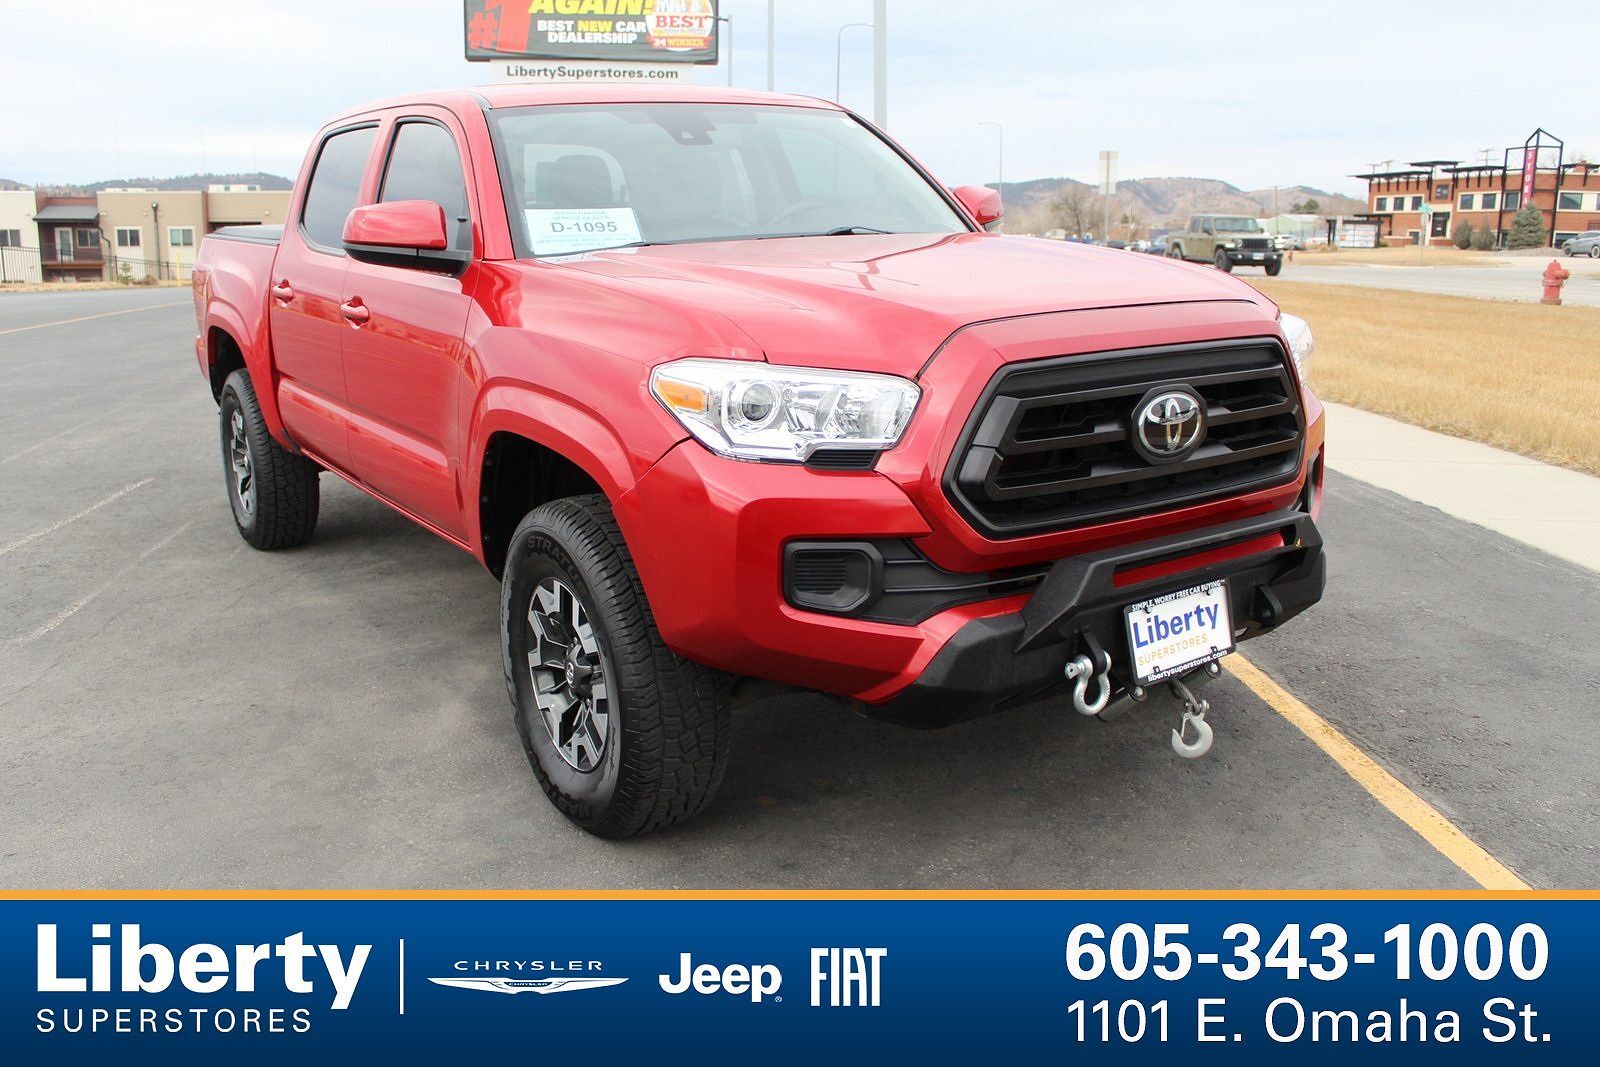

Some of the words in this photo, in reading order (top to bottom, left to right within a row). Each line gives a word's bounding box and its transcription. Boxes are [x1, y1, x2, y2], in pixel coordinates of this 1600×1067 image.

[537, 20, 575, 32] BEST
[577, 20, 613, 32] NEW
[615, 21, 646, 33] CAR
[655, 15, 707, 28] BEST
[547, 32, 638, 44] DEALERSHIP
[506, 65, 679, 80] LibertySuperstores.com
[550, 221, 618, 233] D-1095
[1155, 594, 1177, 605] WORRY
[1176, 589, 1190, 599] FREE
[1189, 586, 1201, 596] CAR
[1132, 603, 1219, 648] Liberty
[1137, 633, 1209, 667] SUPERSTORES
[1147, 649, 1228, 682] libertysuperstores.com
